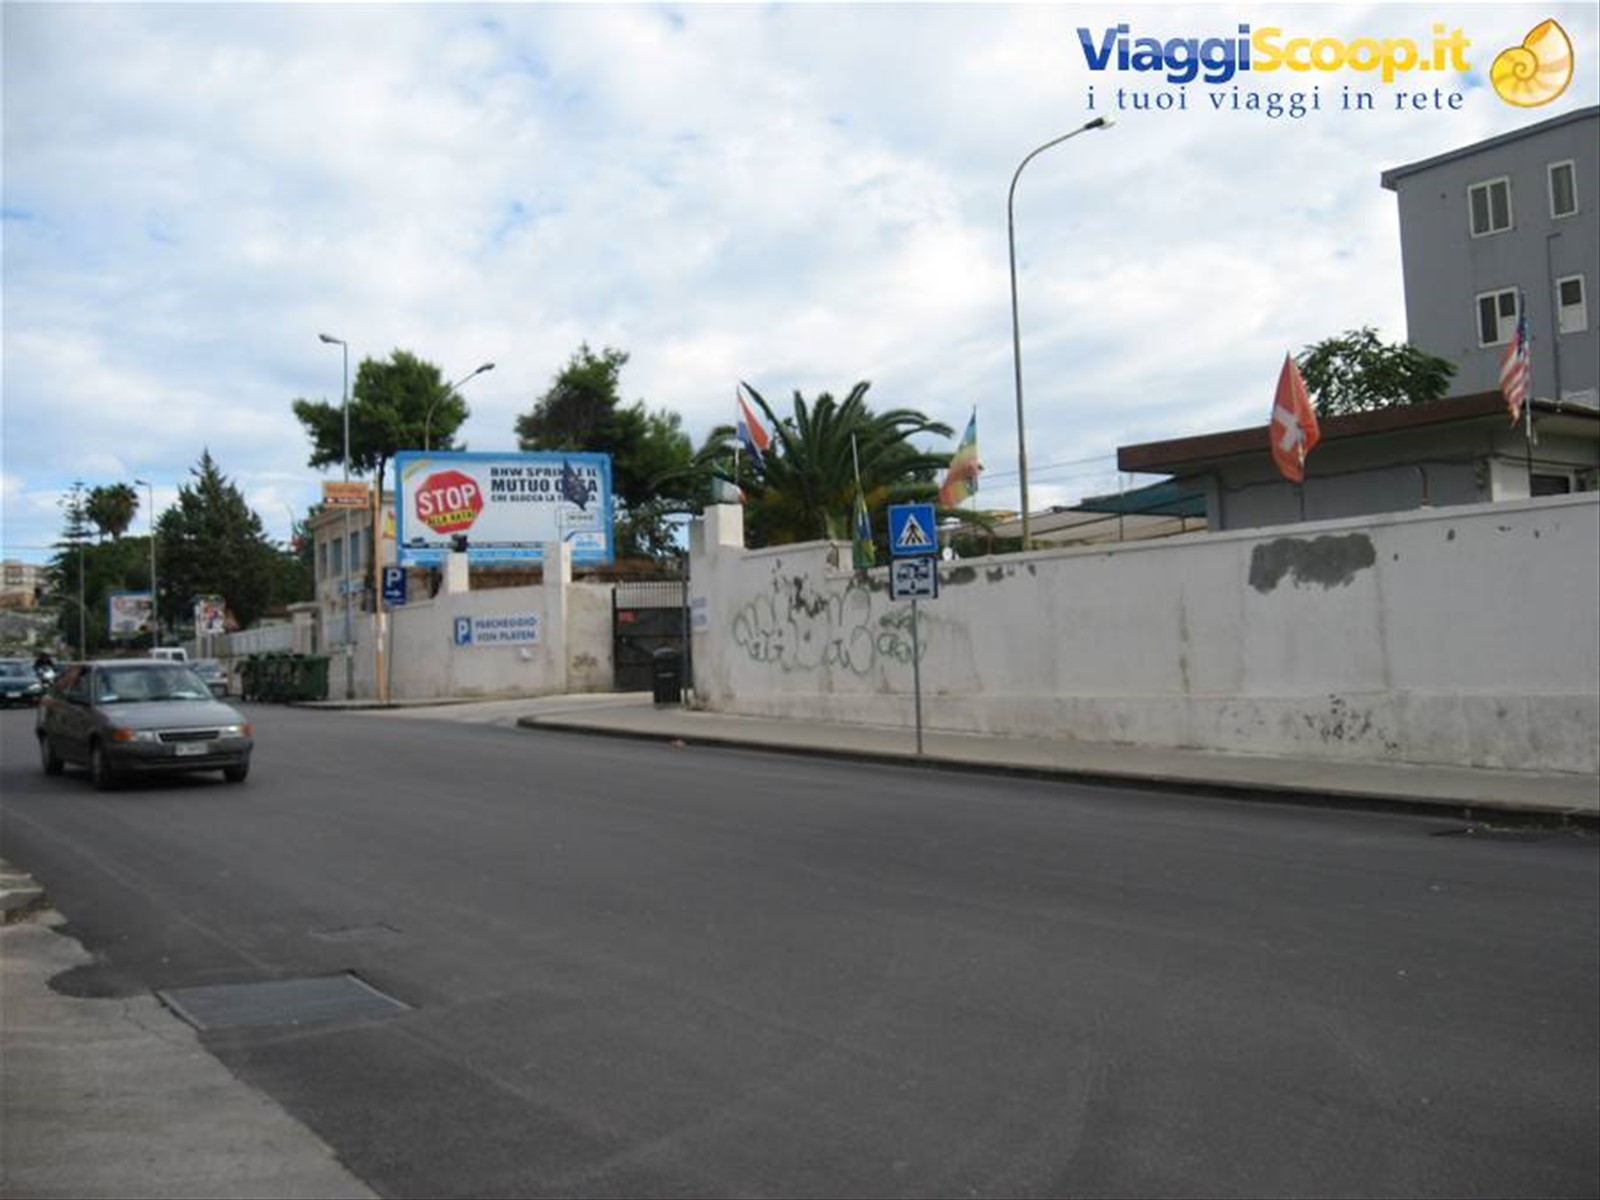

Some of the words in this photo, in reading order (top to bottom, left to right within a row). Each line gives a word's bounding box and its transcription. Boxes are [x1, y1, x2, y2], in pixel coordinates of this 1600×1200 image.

[491, 479, 550, 492] MUTUO
[418, 484, 476, 515] STOP
[386, 568, 402, 588] P
[458, 620, 469, 641] P
